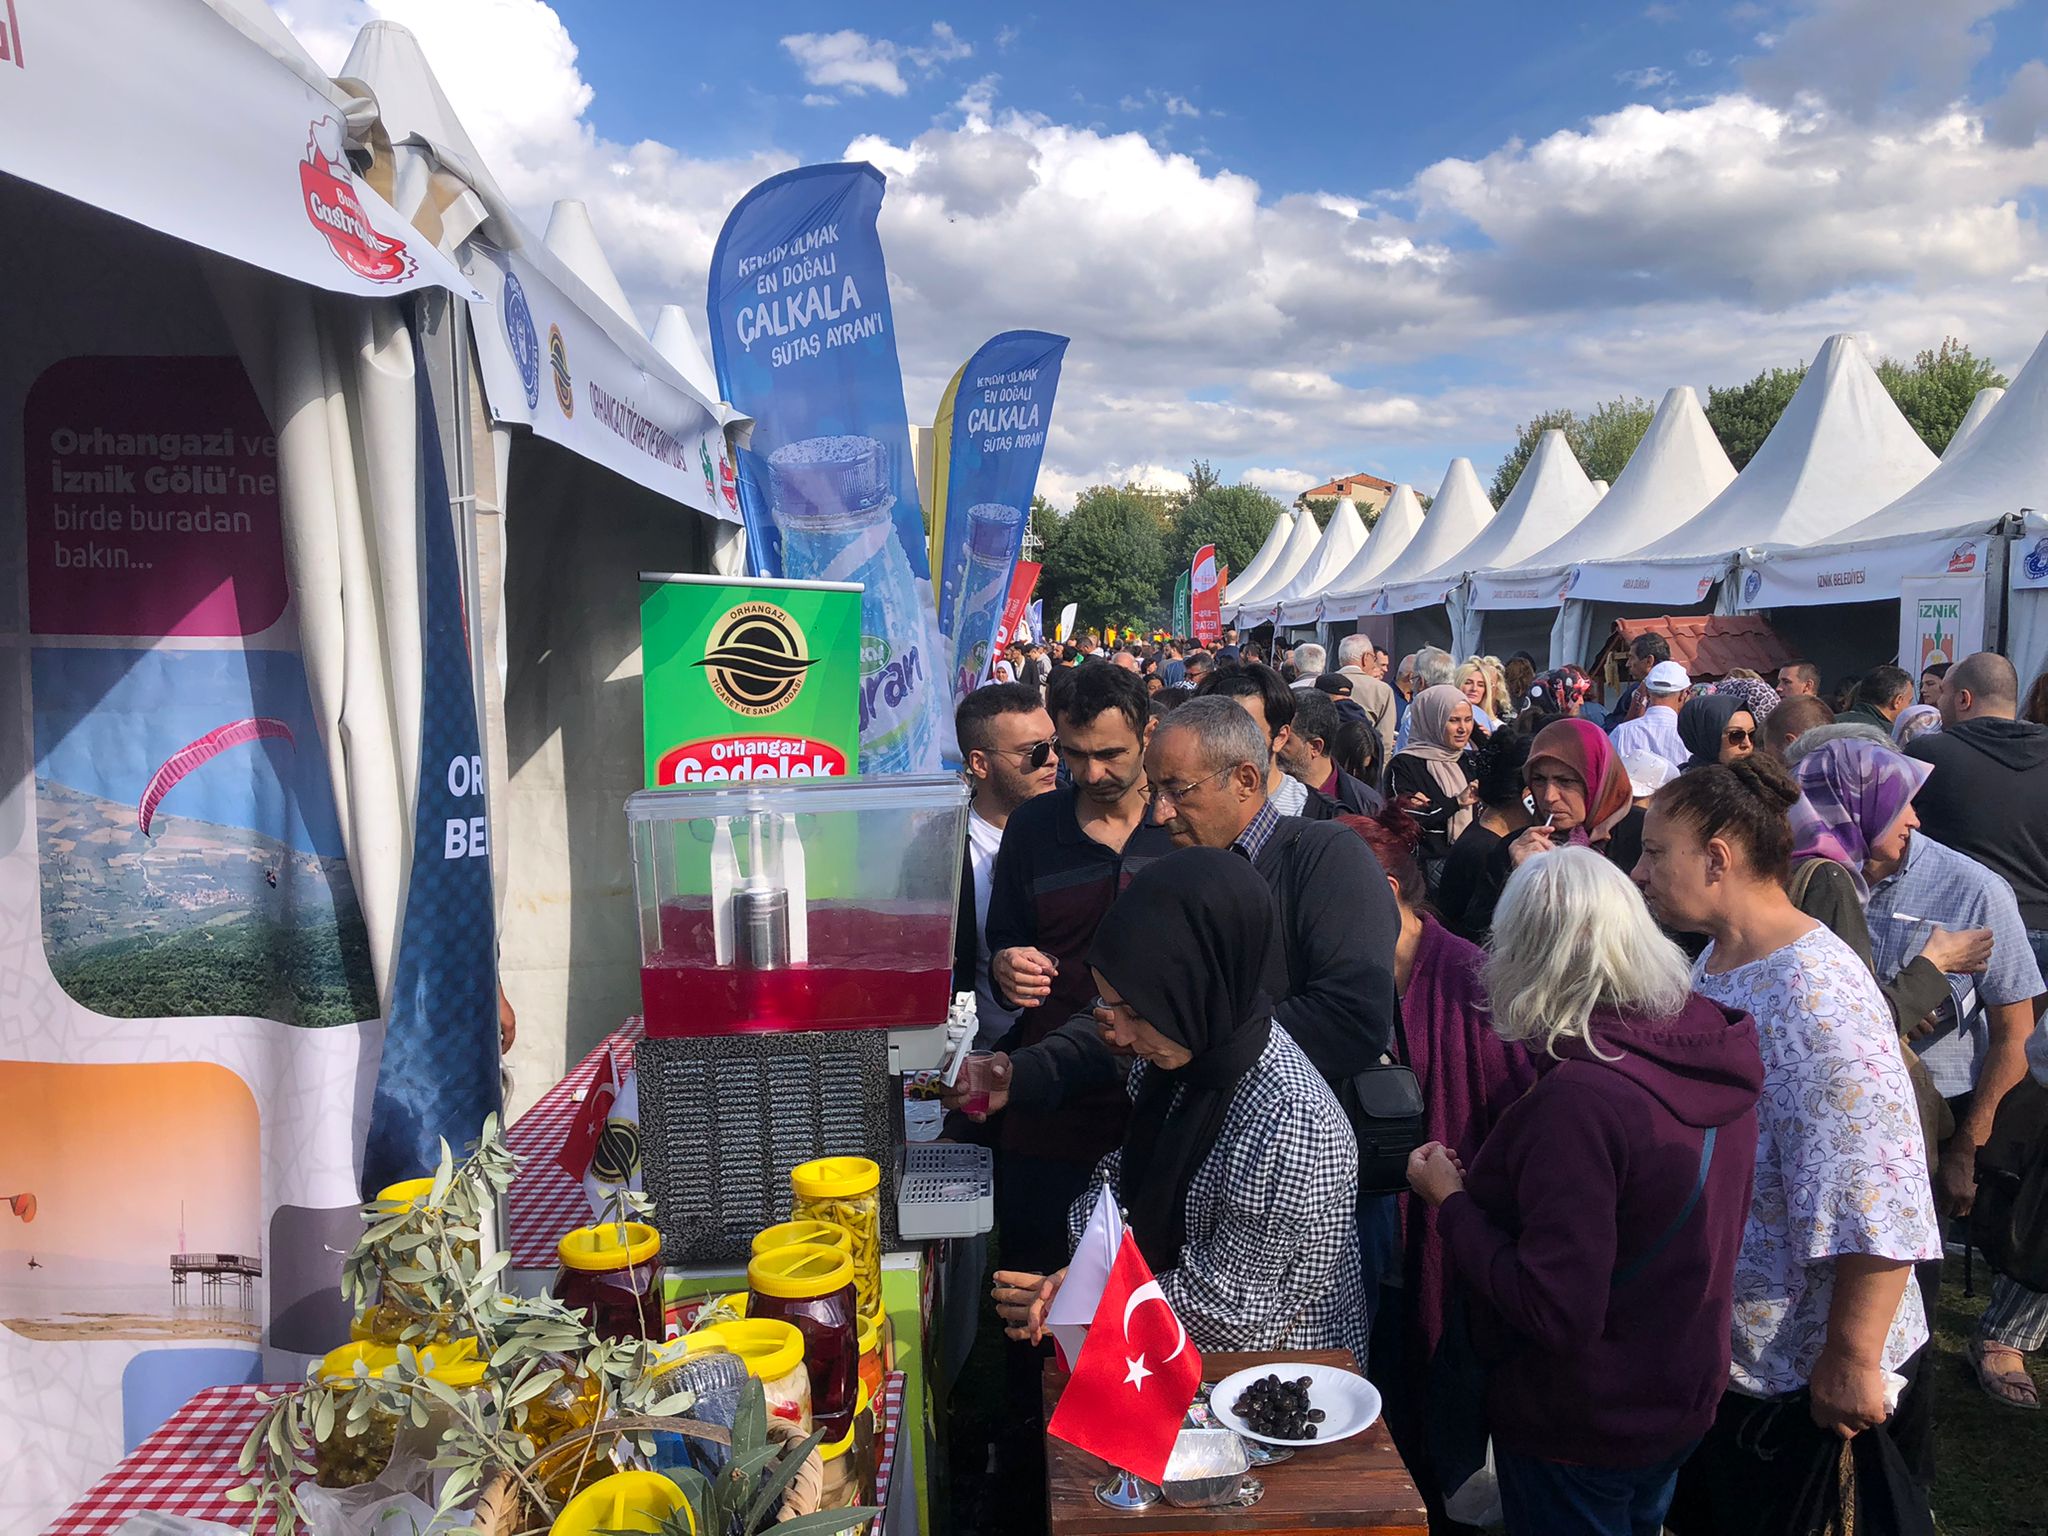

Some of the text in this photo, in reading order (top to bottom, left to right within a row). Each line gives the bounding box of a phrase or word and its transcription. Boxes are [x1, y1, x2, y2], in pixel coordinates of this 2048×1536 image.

[757, 252, 836, 295] EN DOĞALI
[736, 275, 862, 352] ÇALKALA
[771, 312, 883, 368] SÜTAŞ AYRAN'I
[984, 389, 998, 403] EN
[967, 404, 1039, 438] ÇALKALA
[51, 427, 278, 461] Orhangazi ve
[983, 435, 1013, 453] SÜTAŞ
[51, 459, 277, 495] İznik Gölü'ne
[54, 503, 251, 533] birde buradan
[54, 541, 153, 569] bakın...
[711, 678, 740, 709] TİCARET
[740, 706, 751, 715] VE
[783, 679, 803, 704] ODASI
[711, 739, 806, 761] Orhangazi
[675, 755, 834, 784] Gedelek
[444, 816, 489, 859] BE
